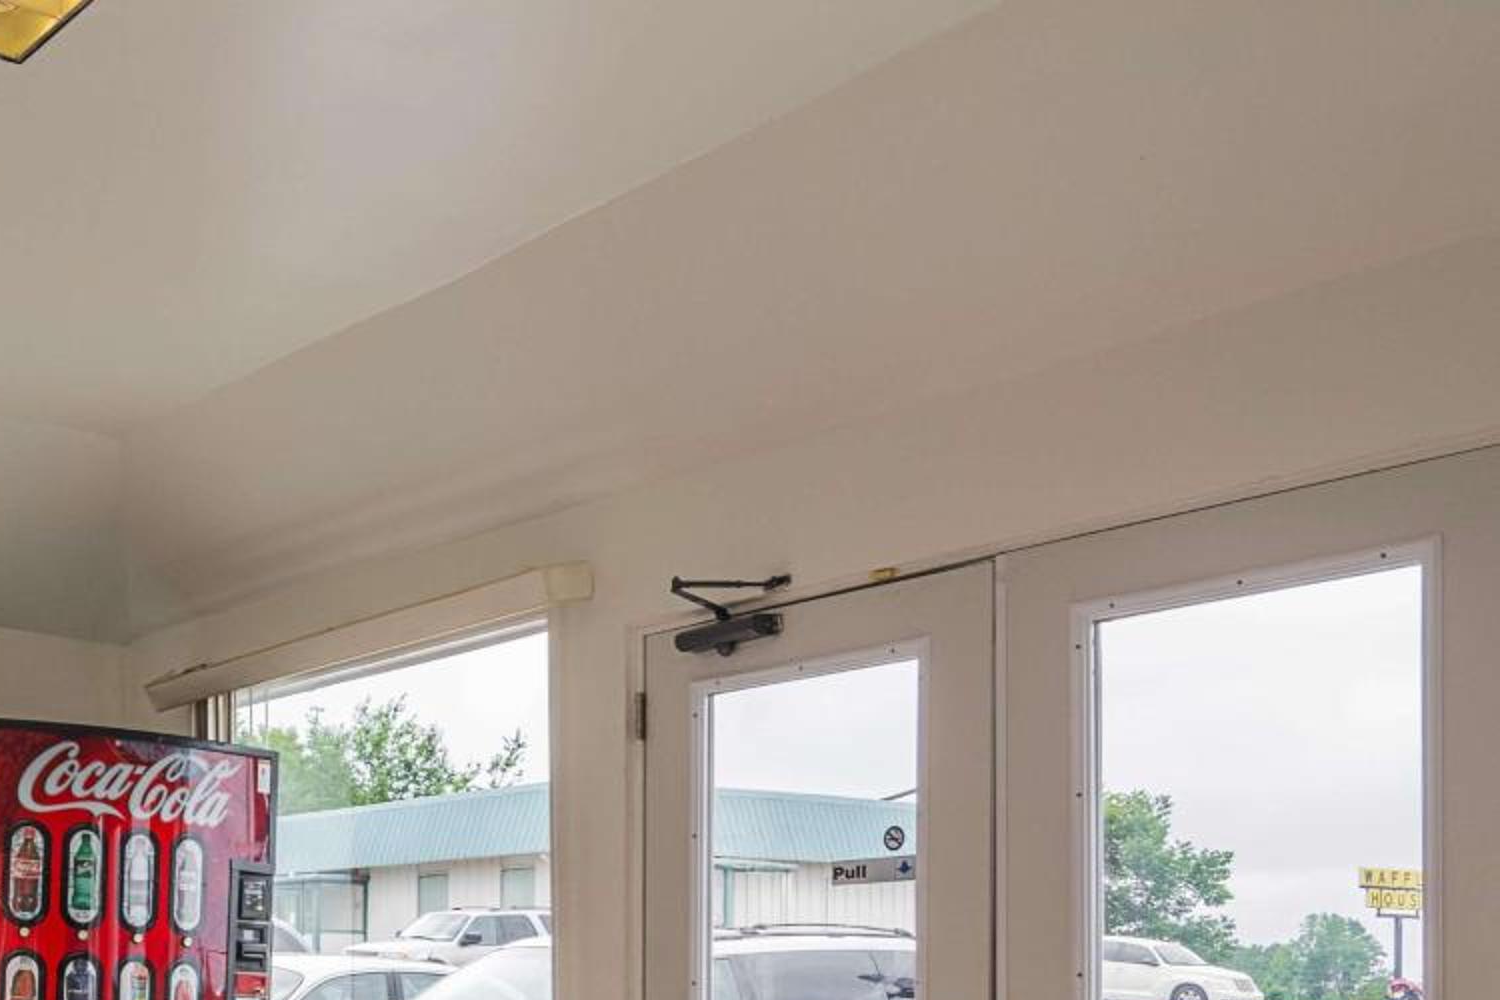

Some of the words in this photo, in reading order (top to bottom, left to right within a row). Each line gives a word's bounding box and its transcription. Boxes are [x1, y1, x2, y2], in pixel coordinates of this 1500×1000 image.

[17, 741, 241, 827] Coca-Cola
[833, 865, 867, 880] Pull
[1365, 870, 1413, 884] WAFF
[1371, 892, 1417, 908] HOUS
